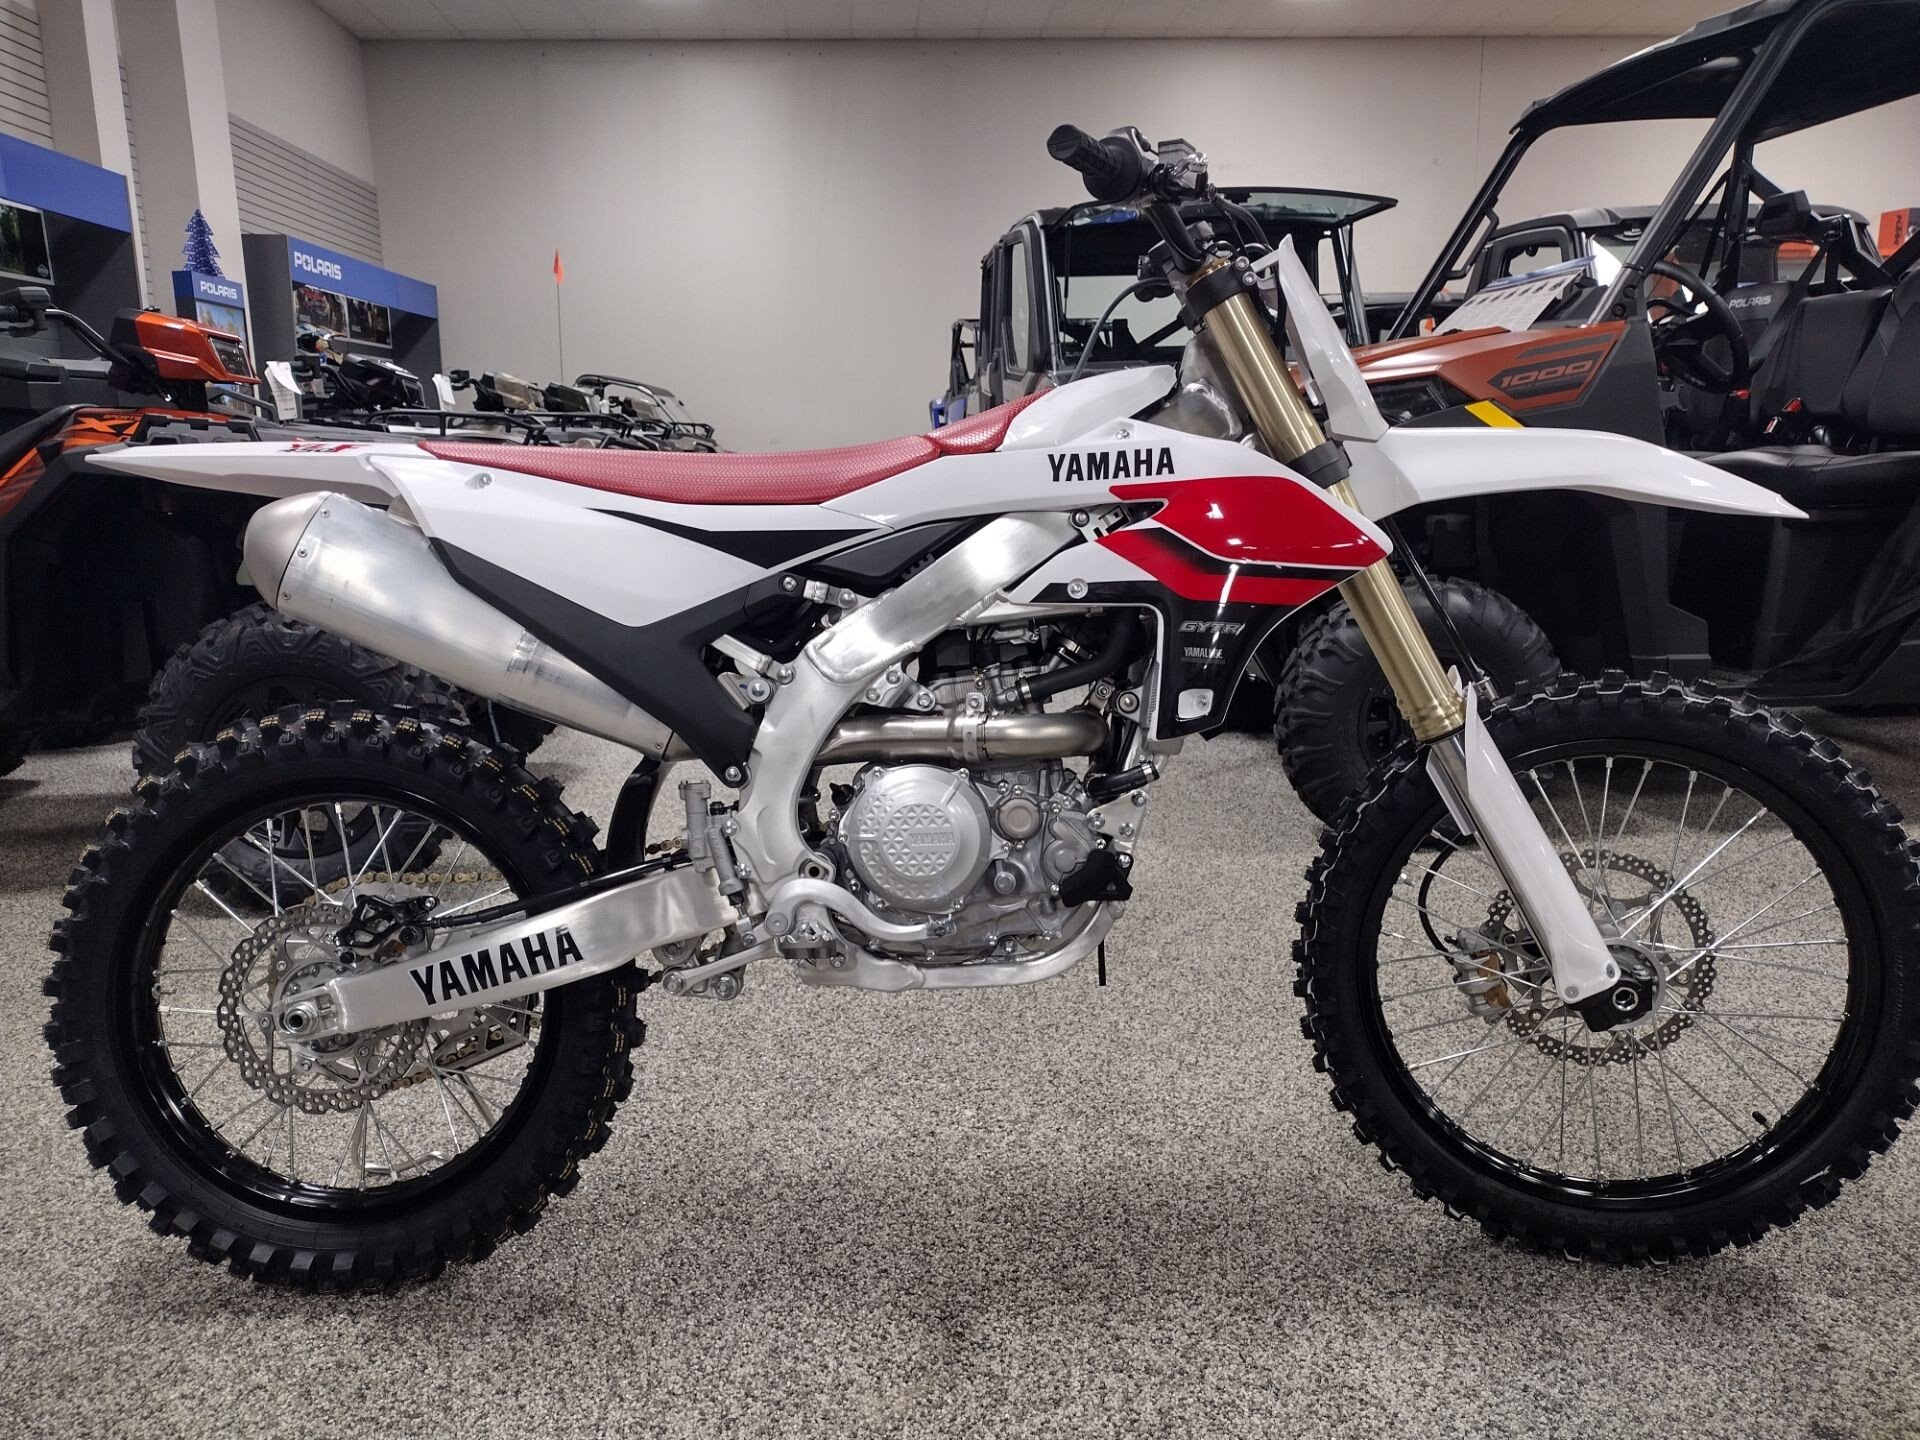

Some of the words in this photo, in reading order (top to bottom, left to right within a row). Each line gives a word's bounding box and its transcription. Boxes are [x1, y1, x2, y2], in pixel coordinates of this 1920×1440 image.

[293, 251, 342, 281] POLARIS
[200, 280, 238, 300] POLARIS
[1729, 294, 1773, 309] POLARIS
[1501, 360, 1593, 388] 1000
[1047, 447, 1175, 482] YAMAHA
[1179, 620, 1241, 635] GYTR
[908, 831, 956, 847] YAMAHA
[409, 923, 584, 1006] YAMAHA
